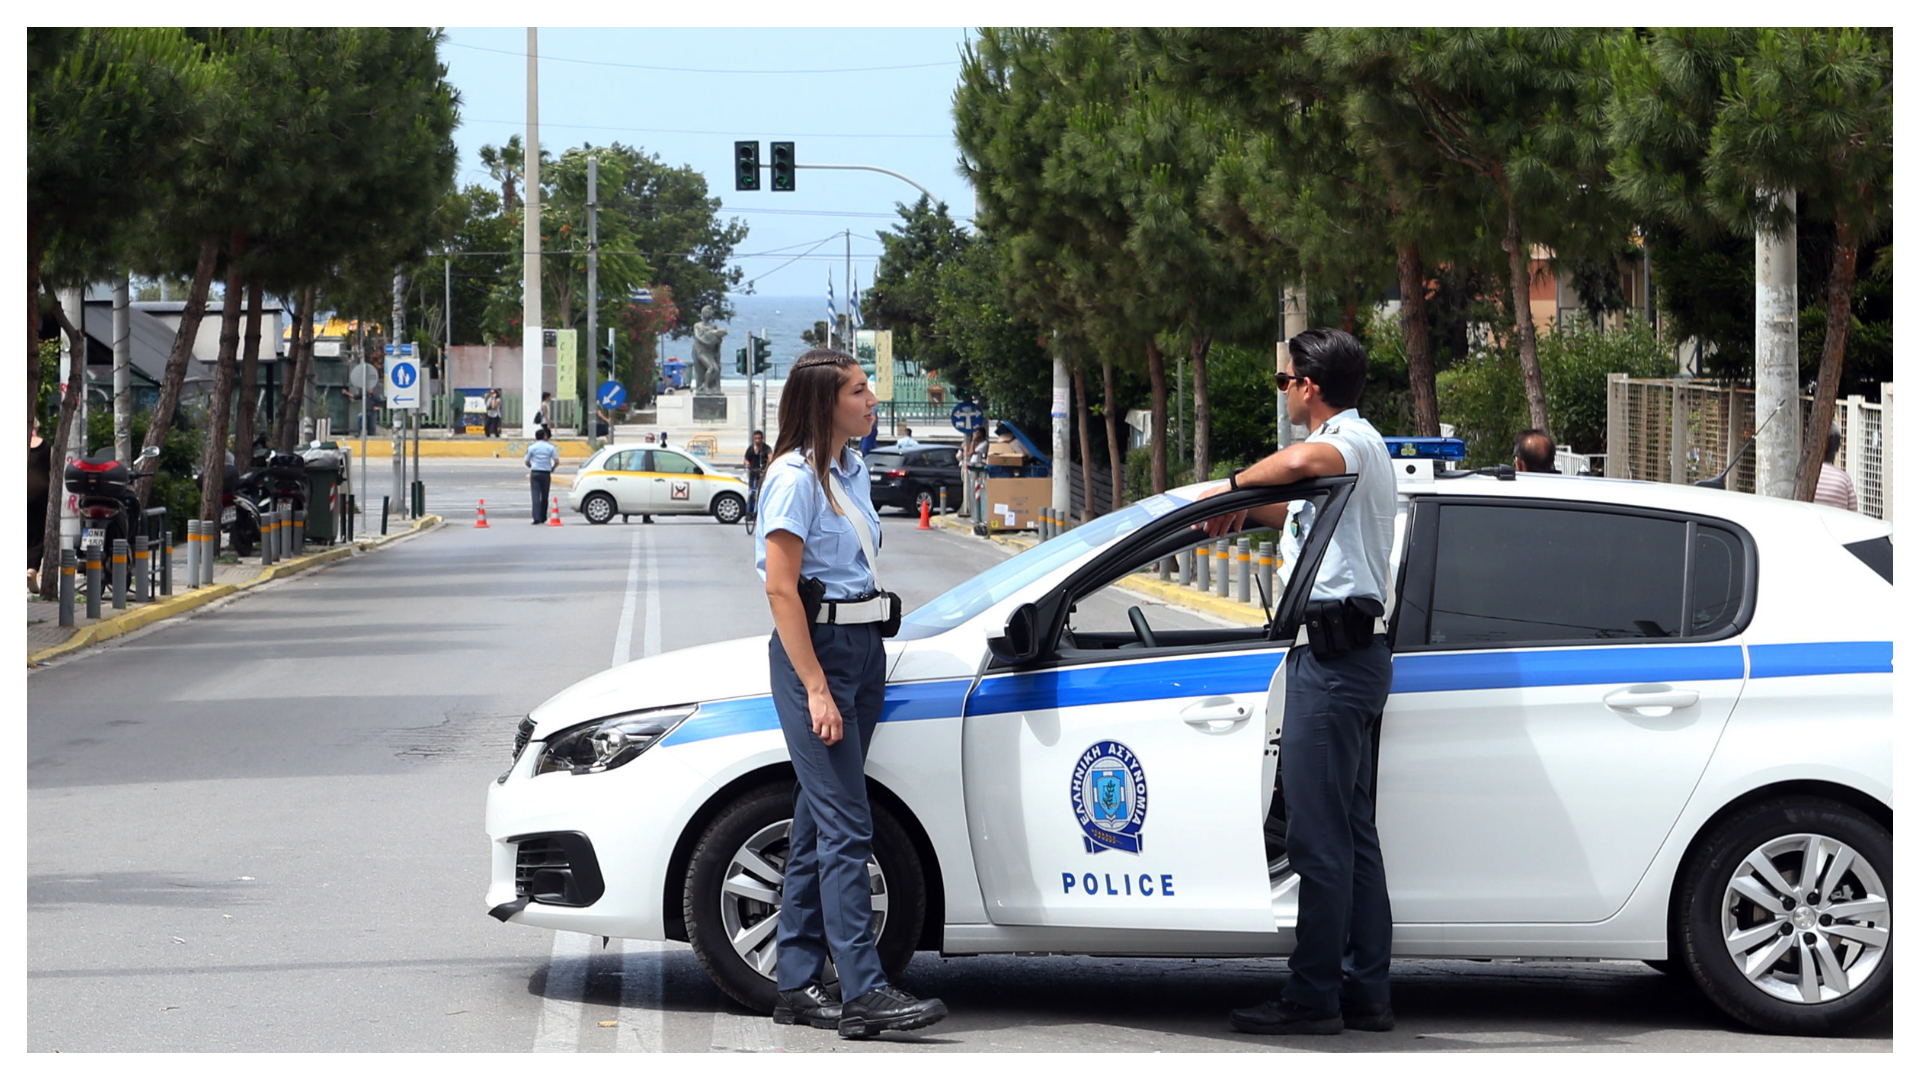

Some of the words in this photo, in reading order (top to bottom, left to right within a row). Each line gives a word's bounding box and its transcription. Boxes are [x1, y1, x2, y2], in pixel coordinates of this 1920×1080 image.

[1072, 745, 1101, 826] ΕΛΛΗΝΙΚΗ
[1108, 743, 1146, 825] ΑΣΤΥΝΟΜΙΑ
[1062, 872, 1175, 896] POLICE
